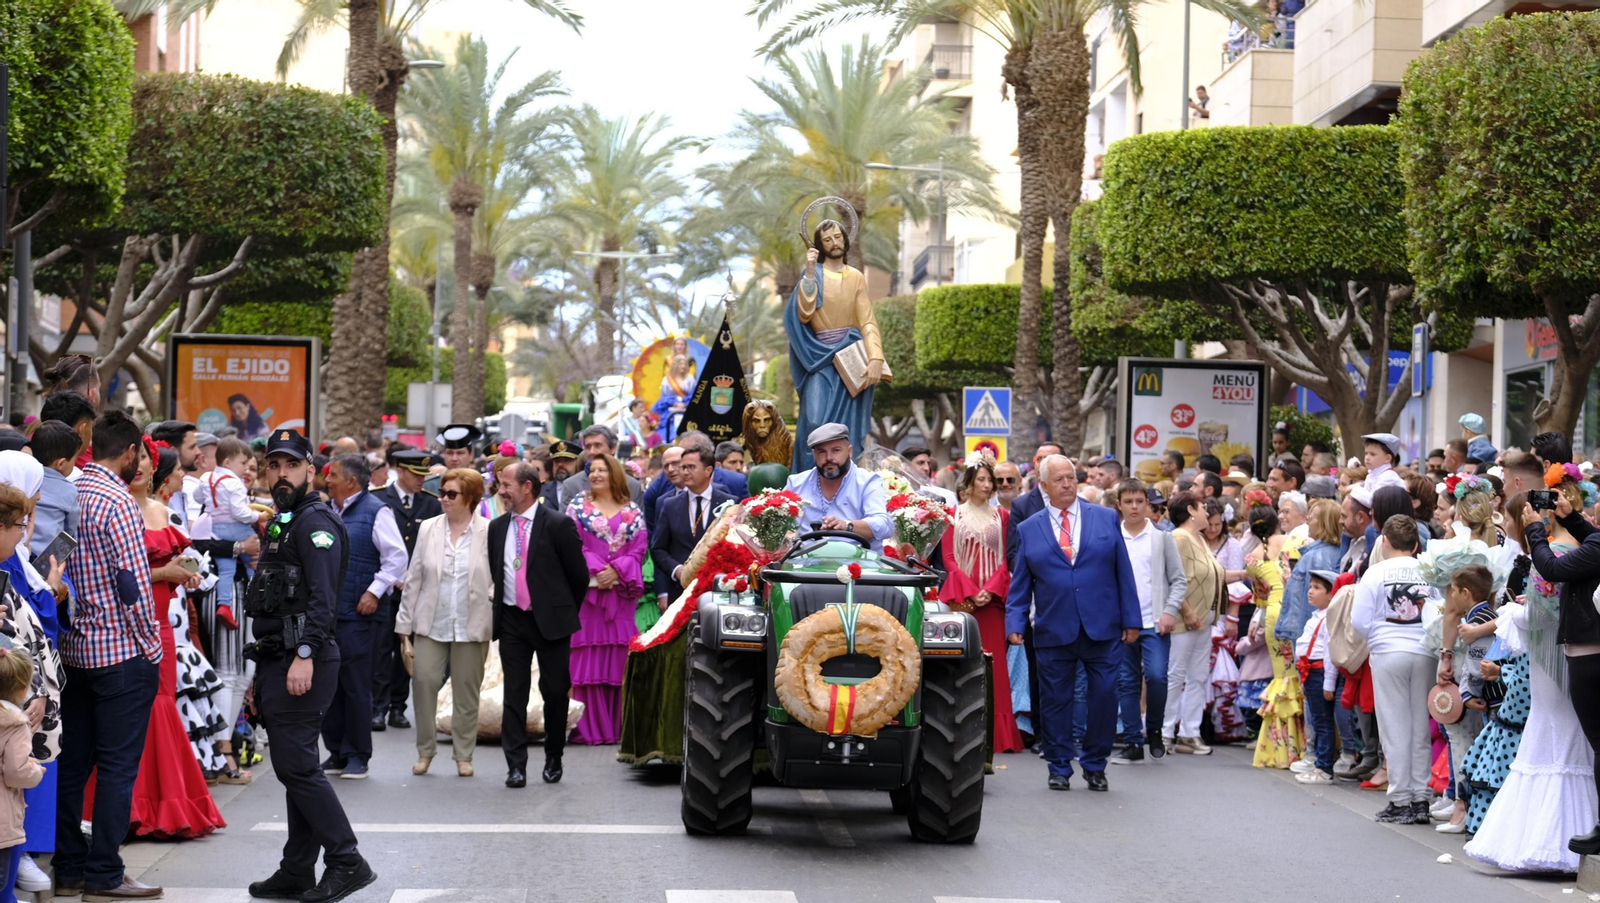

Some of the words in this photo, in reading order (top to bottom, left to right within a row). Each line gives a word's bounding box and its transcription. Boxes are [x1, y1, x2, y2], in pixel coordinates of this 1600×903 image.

[193, 357, 218, 373] EL
[226, 358, 290, 375] EJIDO
[218, 373, 249, 381] FERNÁN
[251, 374, 290, 382] GONZÁLEZ
[1213, 372, 1255, 387] MENÚ
[692, 380, 709, 404] BANDA
[1213, 387, 1254, 400] 4YOU
[1383, 567, 1424, 581] GOK
